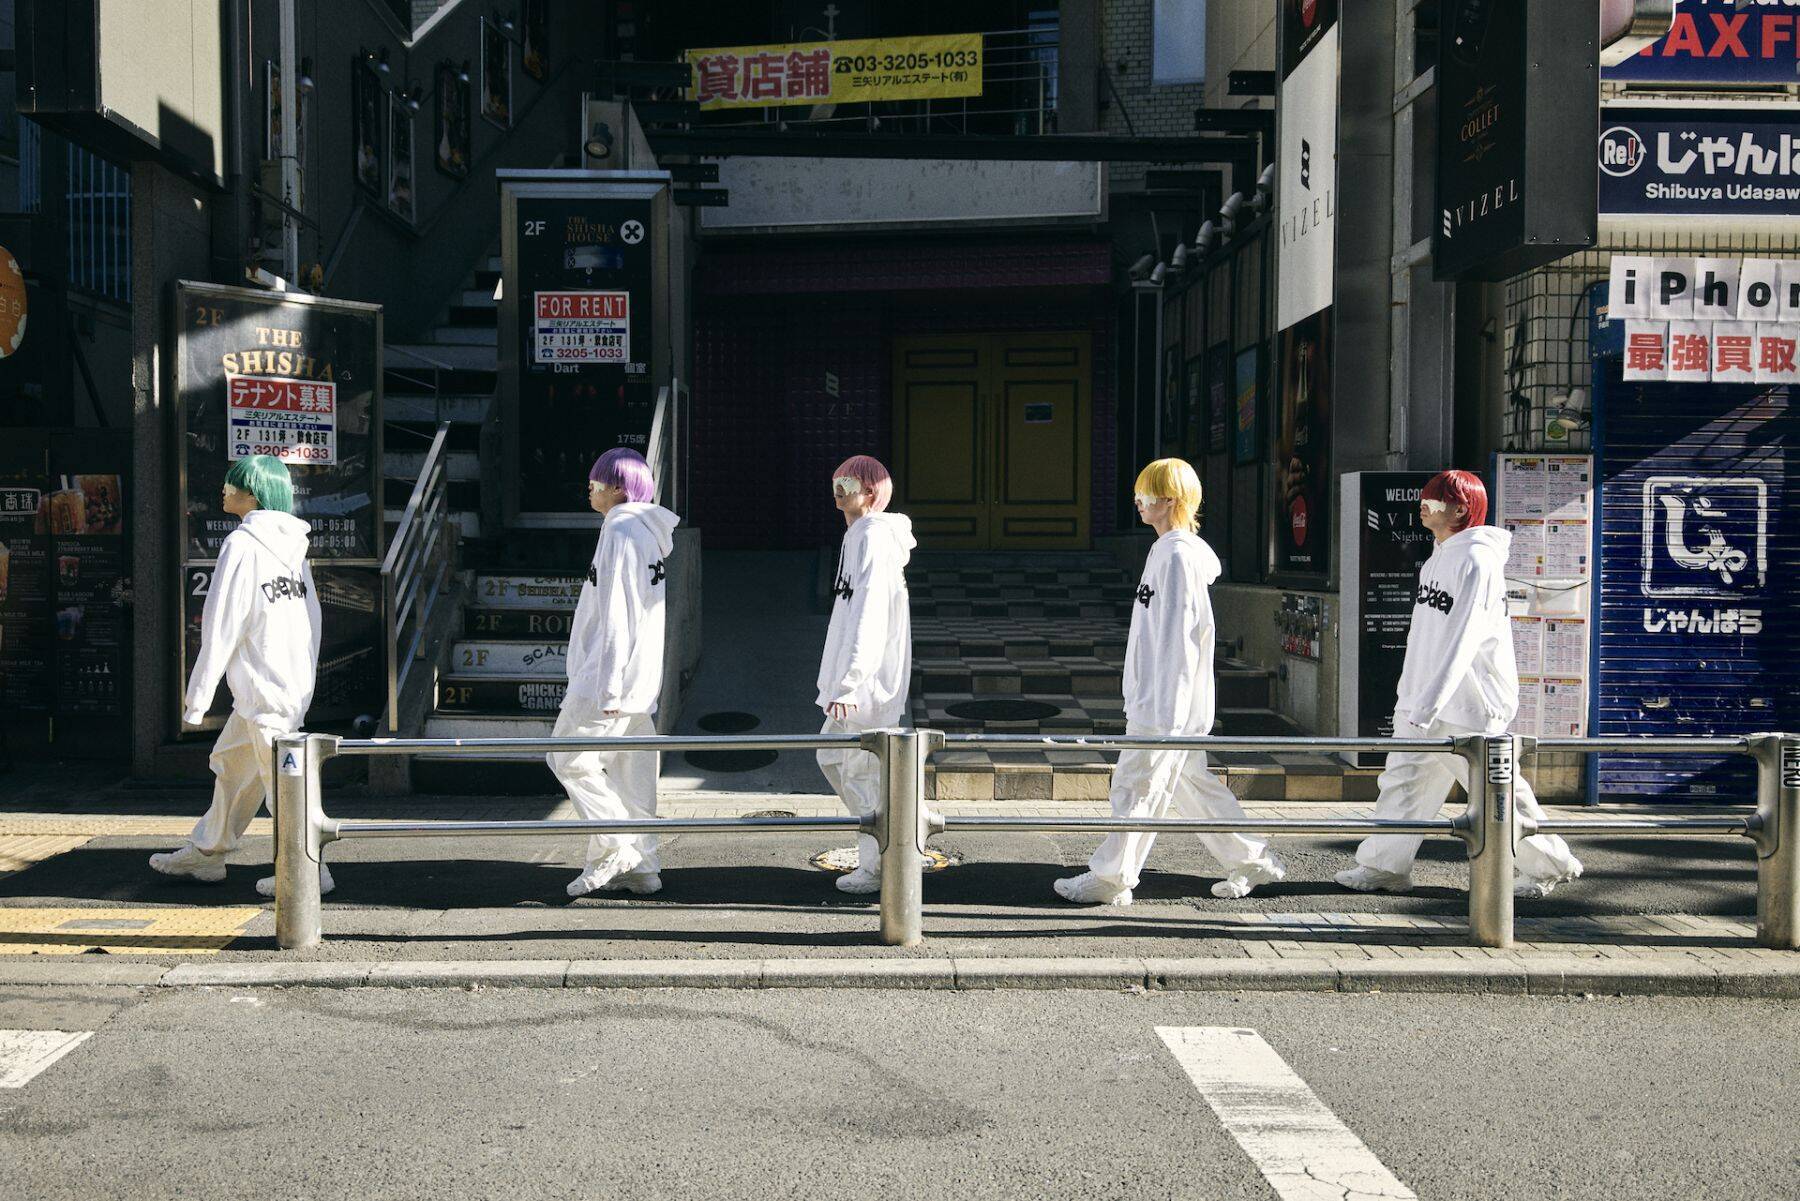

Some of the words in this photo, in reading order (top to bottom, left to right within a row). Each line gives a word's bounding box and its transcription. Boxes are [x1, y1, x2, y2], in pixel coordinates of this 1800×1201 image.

[1639, 13, 1750, 58] AX
[854, 51, 978, 73] 03-3205-1033
[697, 49, 830, 100] 貸店舗
[1461, 104, 1500, 142] COLLET
[1645, 183, 1722, 200] Shibuya
[1456, 179, 1518, 227] VIZEL
[1282, 190, 1334, 248] VIZEL
[524, 221, 546, 236] 2F
[540, 297, 572, 317] FOR
[580, 297, 624, 317] RENT
[196, 307, 224, 327] 2F
[256, 327, 302, 348] THE
[543, 336, 554, 345] 2F
[556, 348, 623, 358] 3205-1033
[1627, 333, 1797, 373] 最強買取
[222, 350, 334, 382] SHISHA
[232, 381, 332, 412] テナント募集
[236, 428, 250, 440] 2F
[253, 444, 329, 459] 3205-1033
[292, 484, 312, 495] Bar
[1385, 488, 1423, 502] WELCO
[1391, 530, 1422, 544] Night
[192, 572, 214, 596] 2
[486, 579, 510, 596] 2F
[475, 614, 502, 631] 2F
[463, 649, 489, 666] 2F
[445, 686, 473, 704] 2F
[282, 752, 297, 768] A
